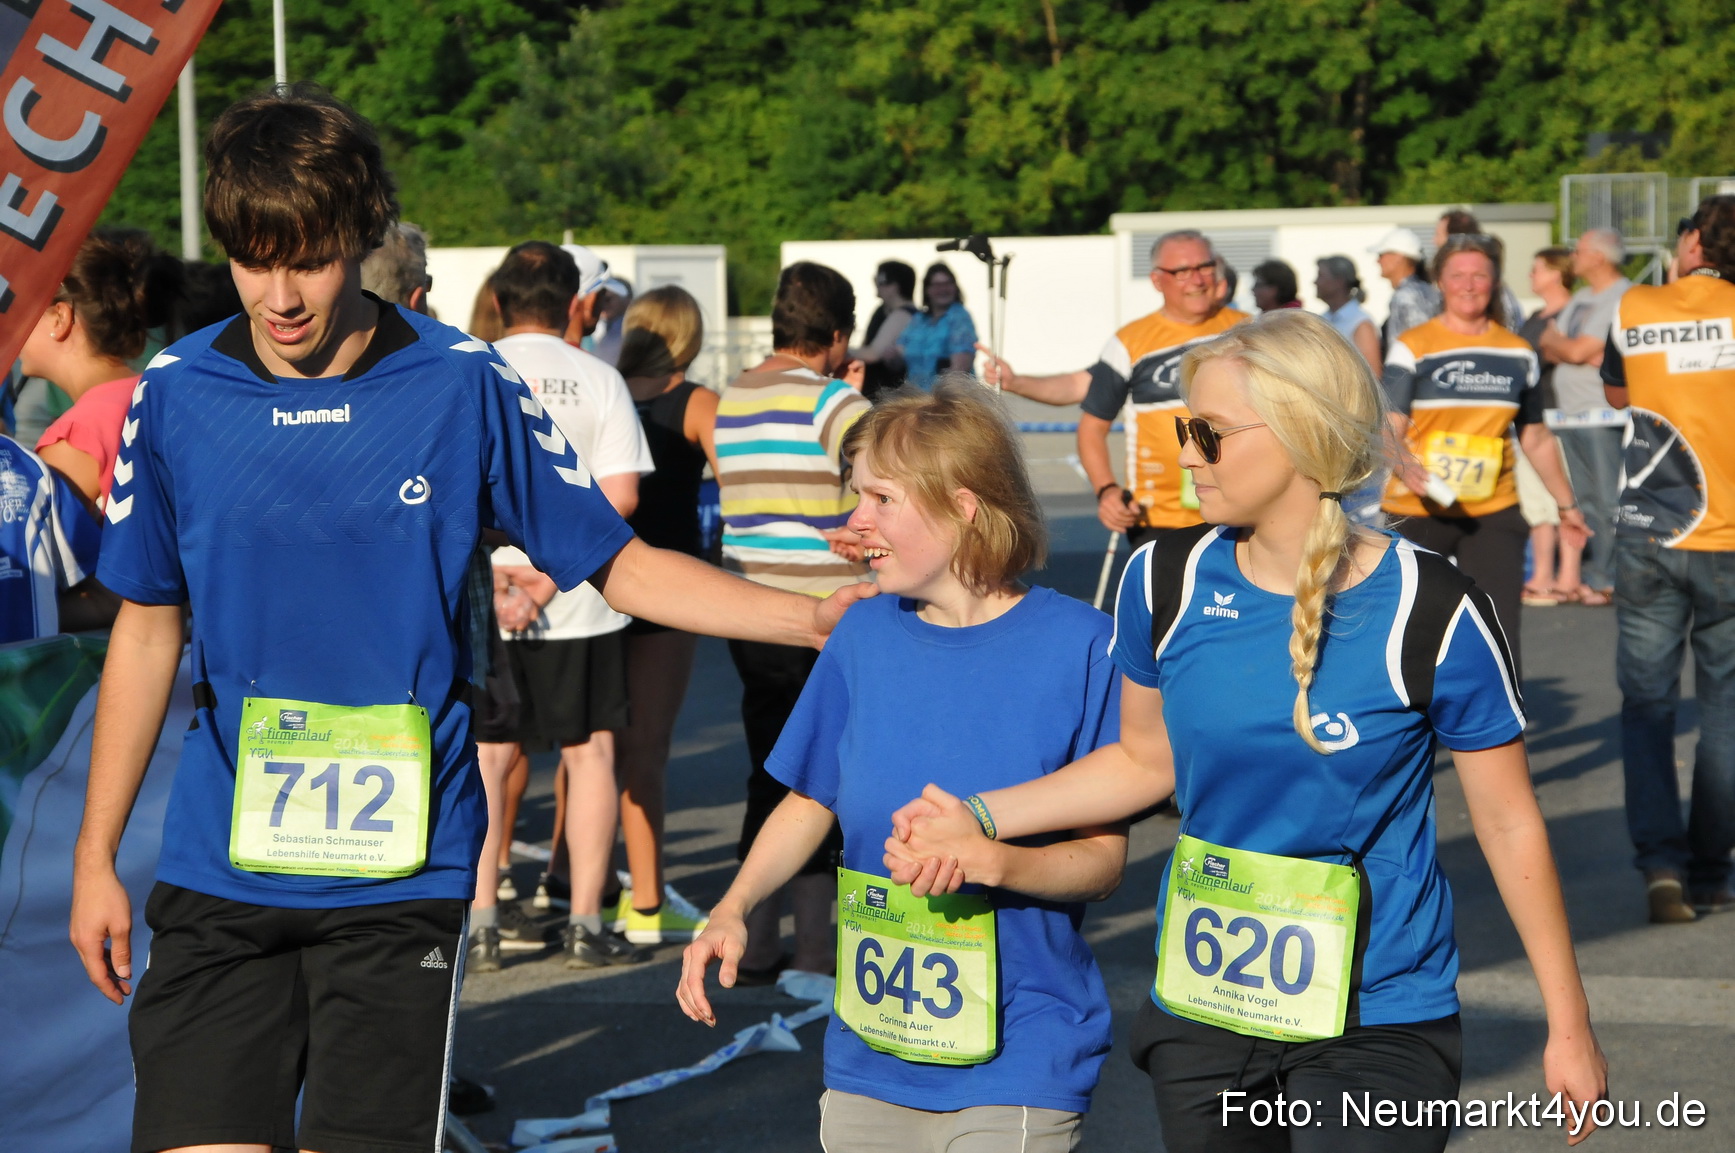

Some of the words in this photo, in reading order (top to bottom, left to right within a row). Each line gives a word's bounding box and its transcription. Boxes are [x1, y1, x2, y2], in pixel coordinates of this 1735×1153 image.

[1626, 320, 1723, 348] Benzin
[1440, 364, 1513, 385] Fischer
[273, 403, 350, 426] hummel
[1438, 455, 1485, 483] 371
[1203, 605, 1239, 619] erima
[267, 727, 332, 741] firmenlauf
[333, 738, 368, 750] 2014
[264, 762, 395, 832] 712
[272, 834, 323, 845] Sebastian
[325, 836, 384, 847] Schmauser
[267, 849, 320, 860] Lebenshilfe
[323, 851, 366, 861] Neumarkt
[369, 854, 386, 862] e.V.
[1191, 869, 1255, 894] firmenlauf
[1255, 891, 1291, 908] 2014
[857, 902, 906, 923] firmenlauf
[906, 922, 935, 936] 2014
[1185, 907, 1316, 995] 620
[420, 960, 448, 969] adidas
[855, 937, 963, 1020] 643
[1213, 985, 1245, 1003] Annika
[1247, 994, 1278, 1009] Vogel
[1188, 994, 1235, 1015] Lebenshilfe
[1237, 1008, 1283, 1024] Neumarkt
[1285, 1018, 1303, 1028] e.V.
[879, 1013, 907, 1029] Corinna
[909, 1020, 933, 1032] Auer
[860, 1024, 897, 1041] Lebenshilfe
[898, 1034, 939, 1048] Neumarkt
[941, 1040, 958, 1049] e.V.
